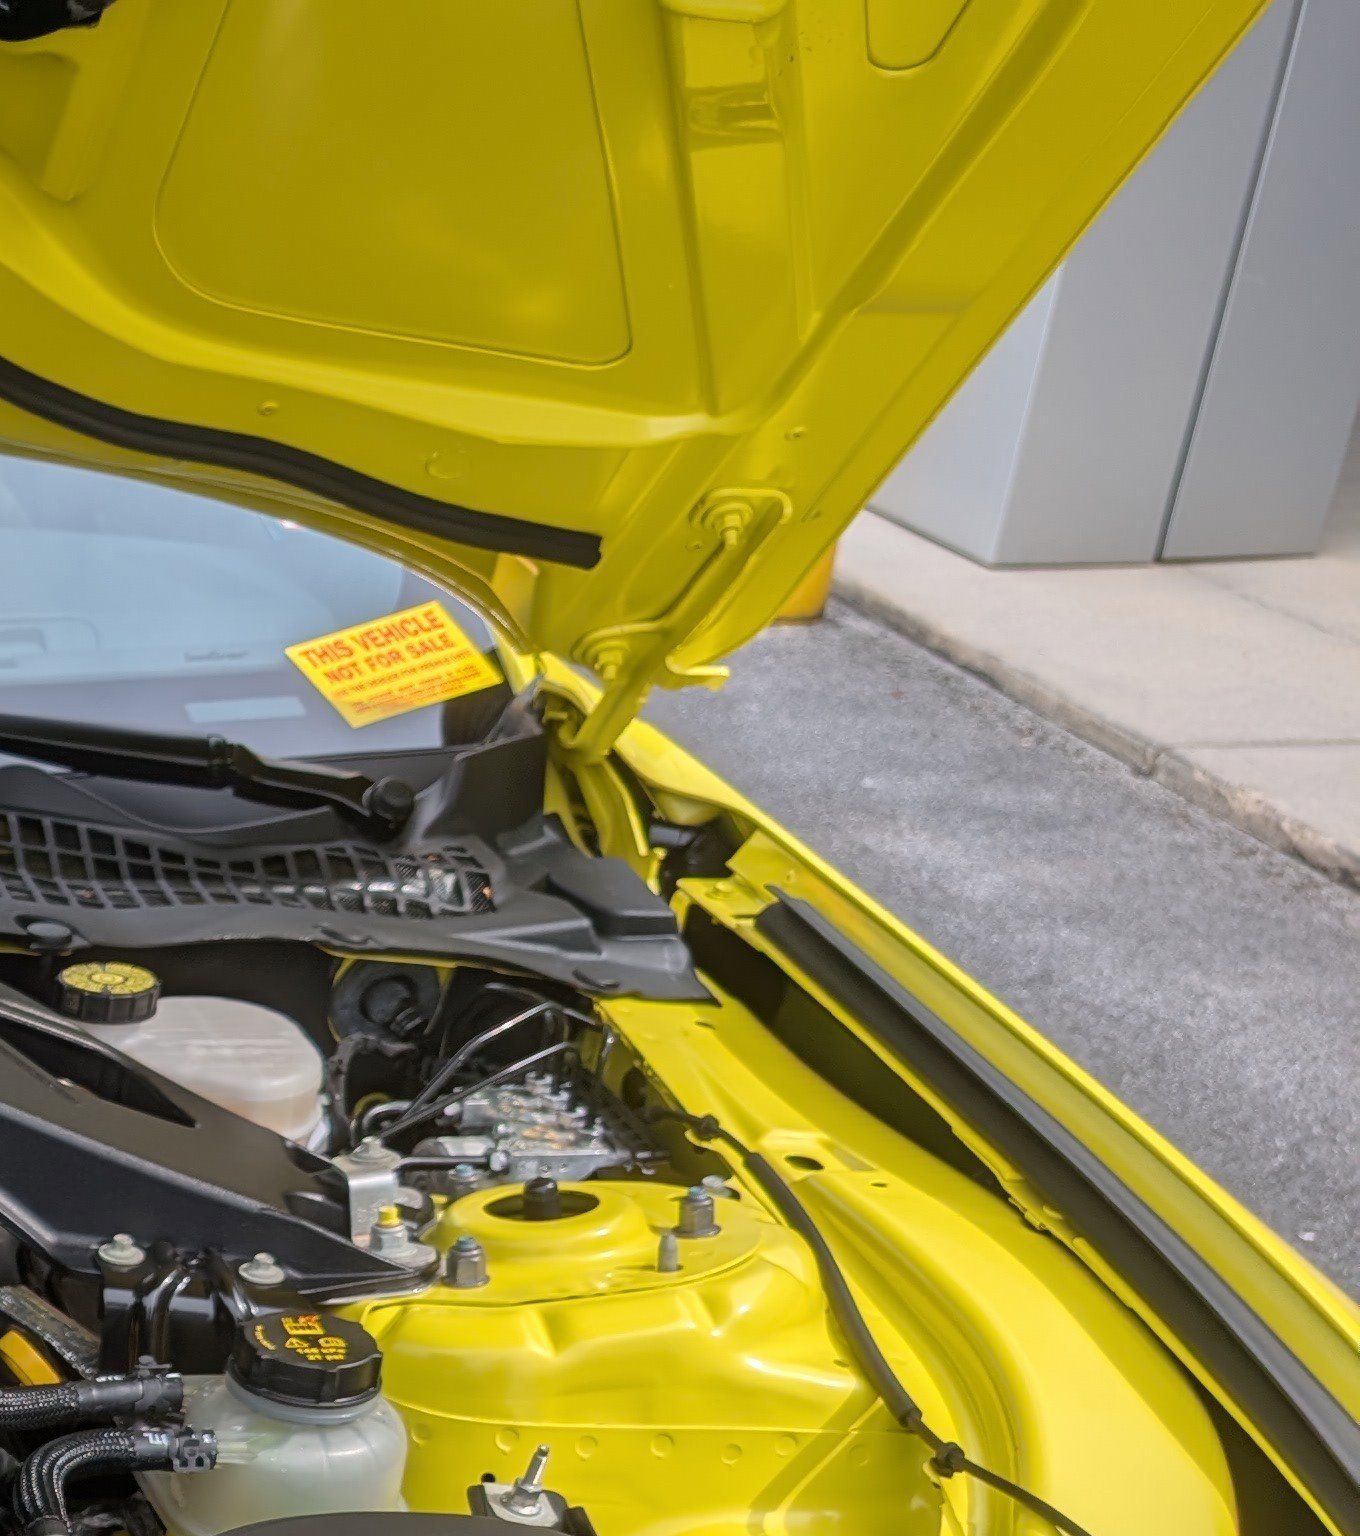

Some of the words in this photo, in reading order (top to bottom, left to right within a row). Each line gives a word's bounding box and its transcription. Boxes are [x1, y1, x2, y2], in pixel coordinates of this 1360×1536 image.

[299, 639, 355, 668] THIS
[351, 610, 445, 651] VEHICLE
[323, 661, 365, 684] NOT
[364, 649, 406, 671] FOR
[405, 631, 456, 659] SALE
